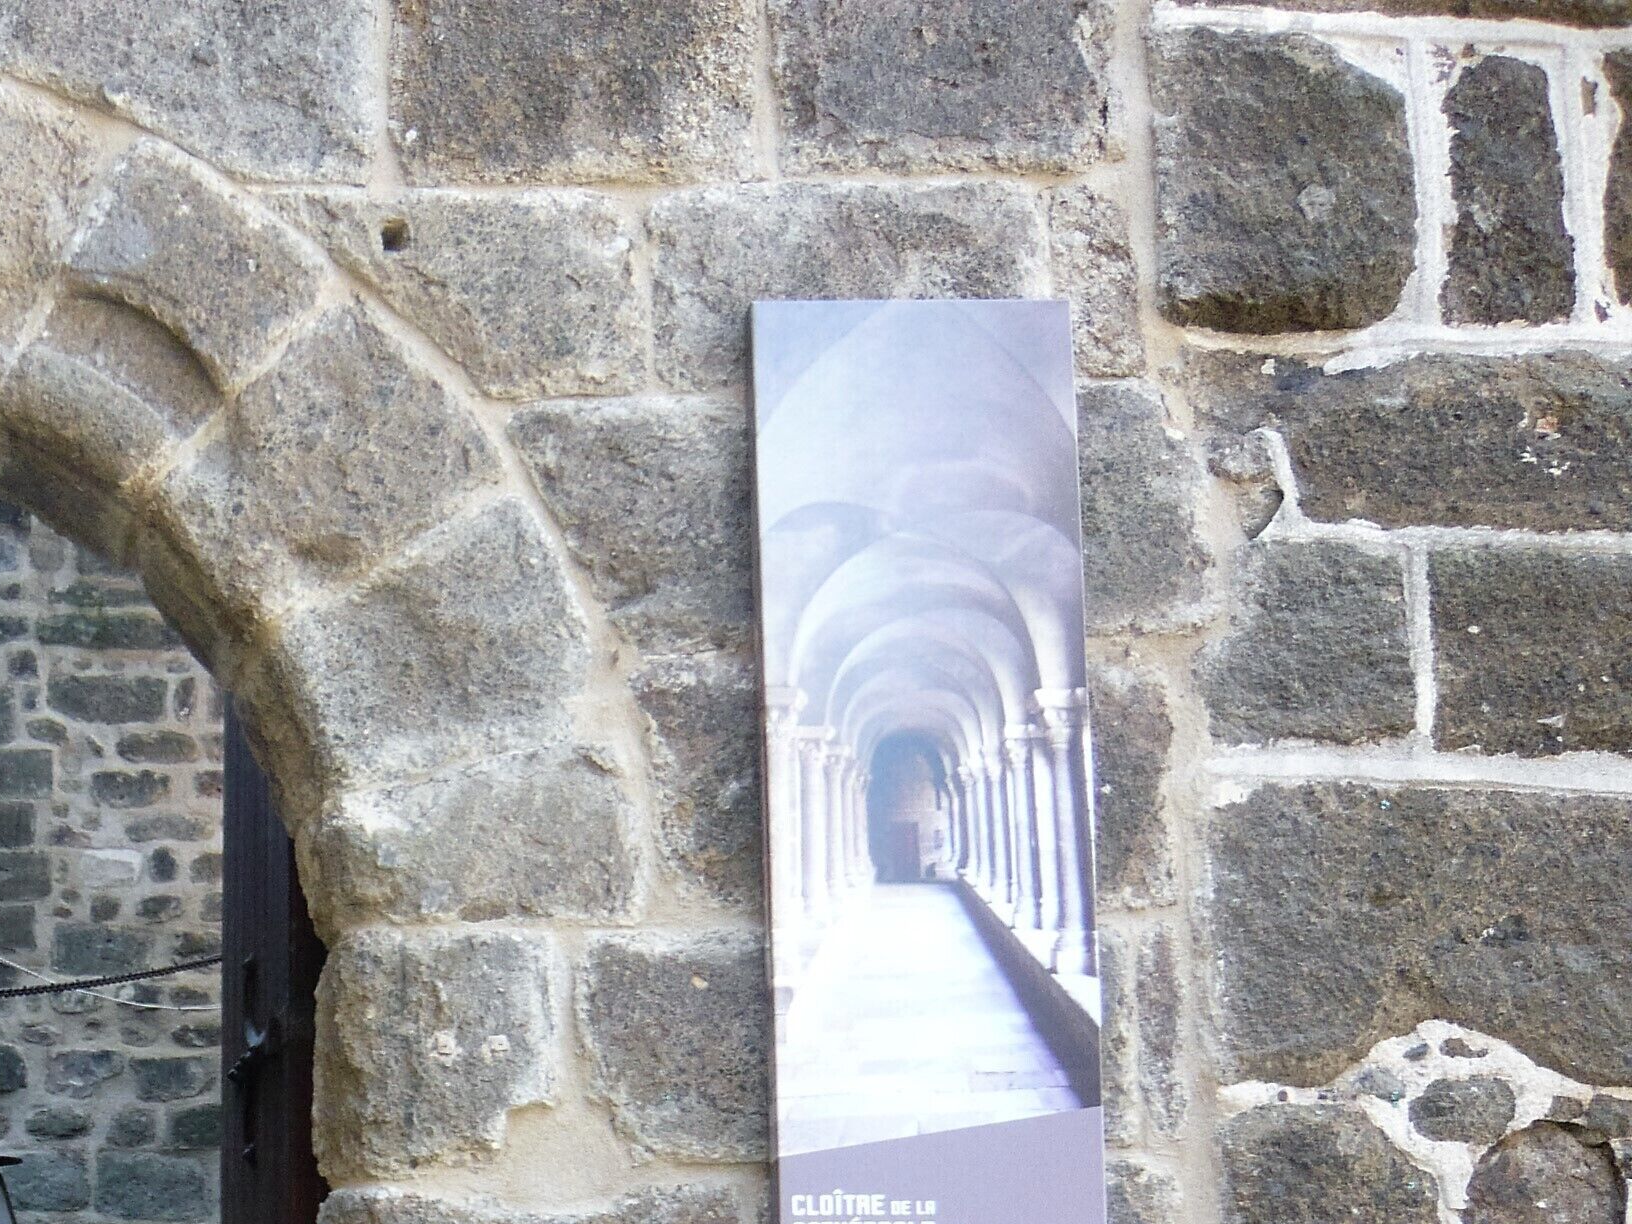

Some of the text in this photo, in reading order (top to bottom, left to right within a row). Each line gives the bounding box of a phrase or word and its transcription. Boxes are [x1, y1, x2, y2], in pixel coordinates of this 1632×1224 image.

[791, 1189, 936, 1216] CLOÎTRE DE LA
